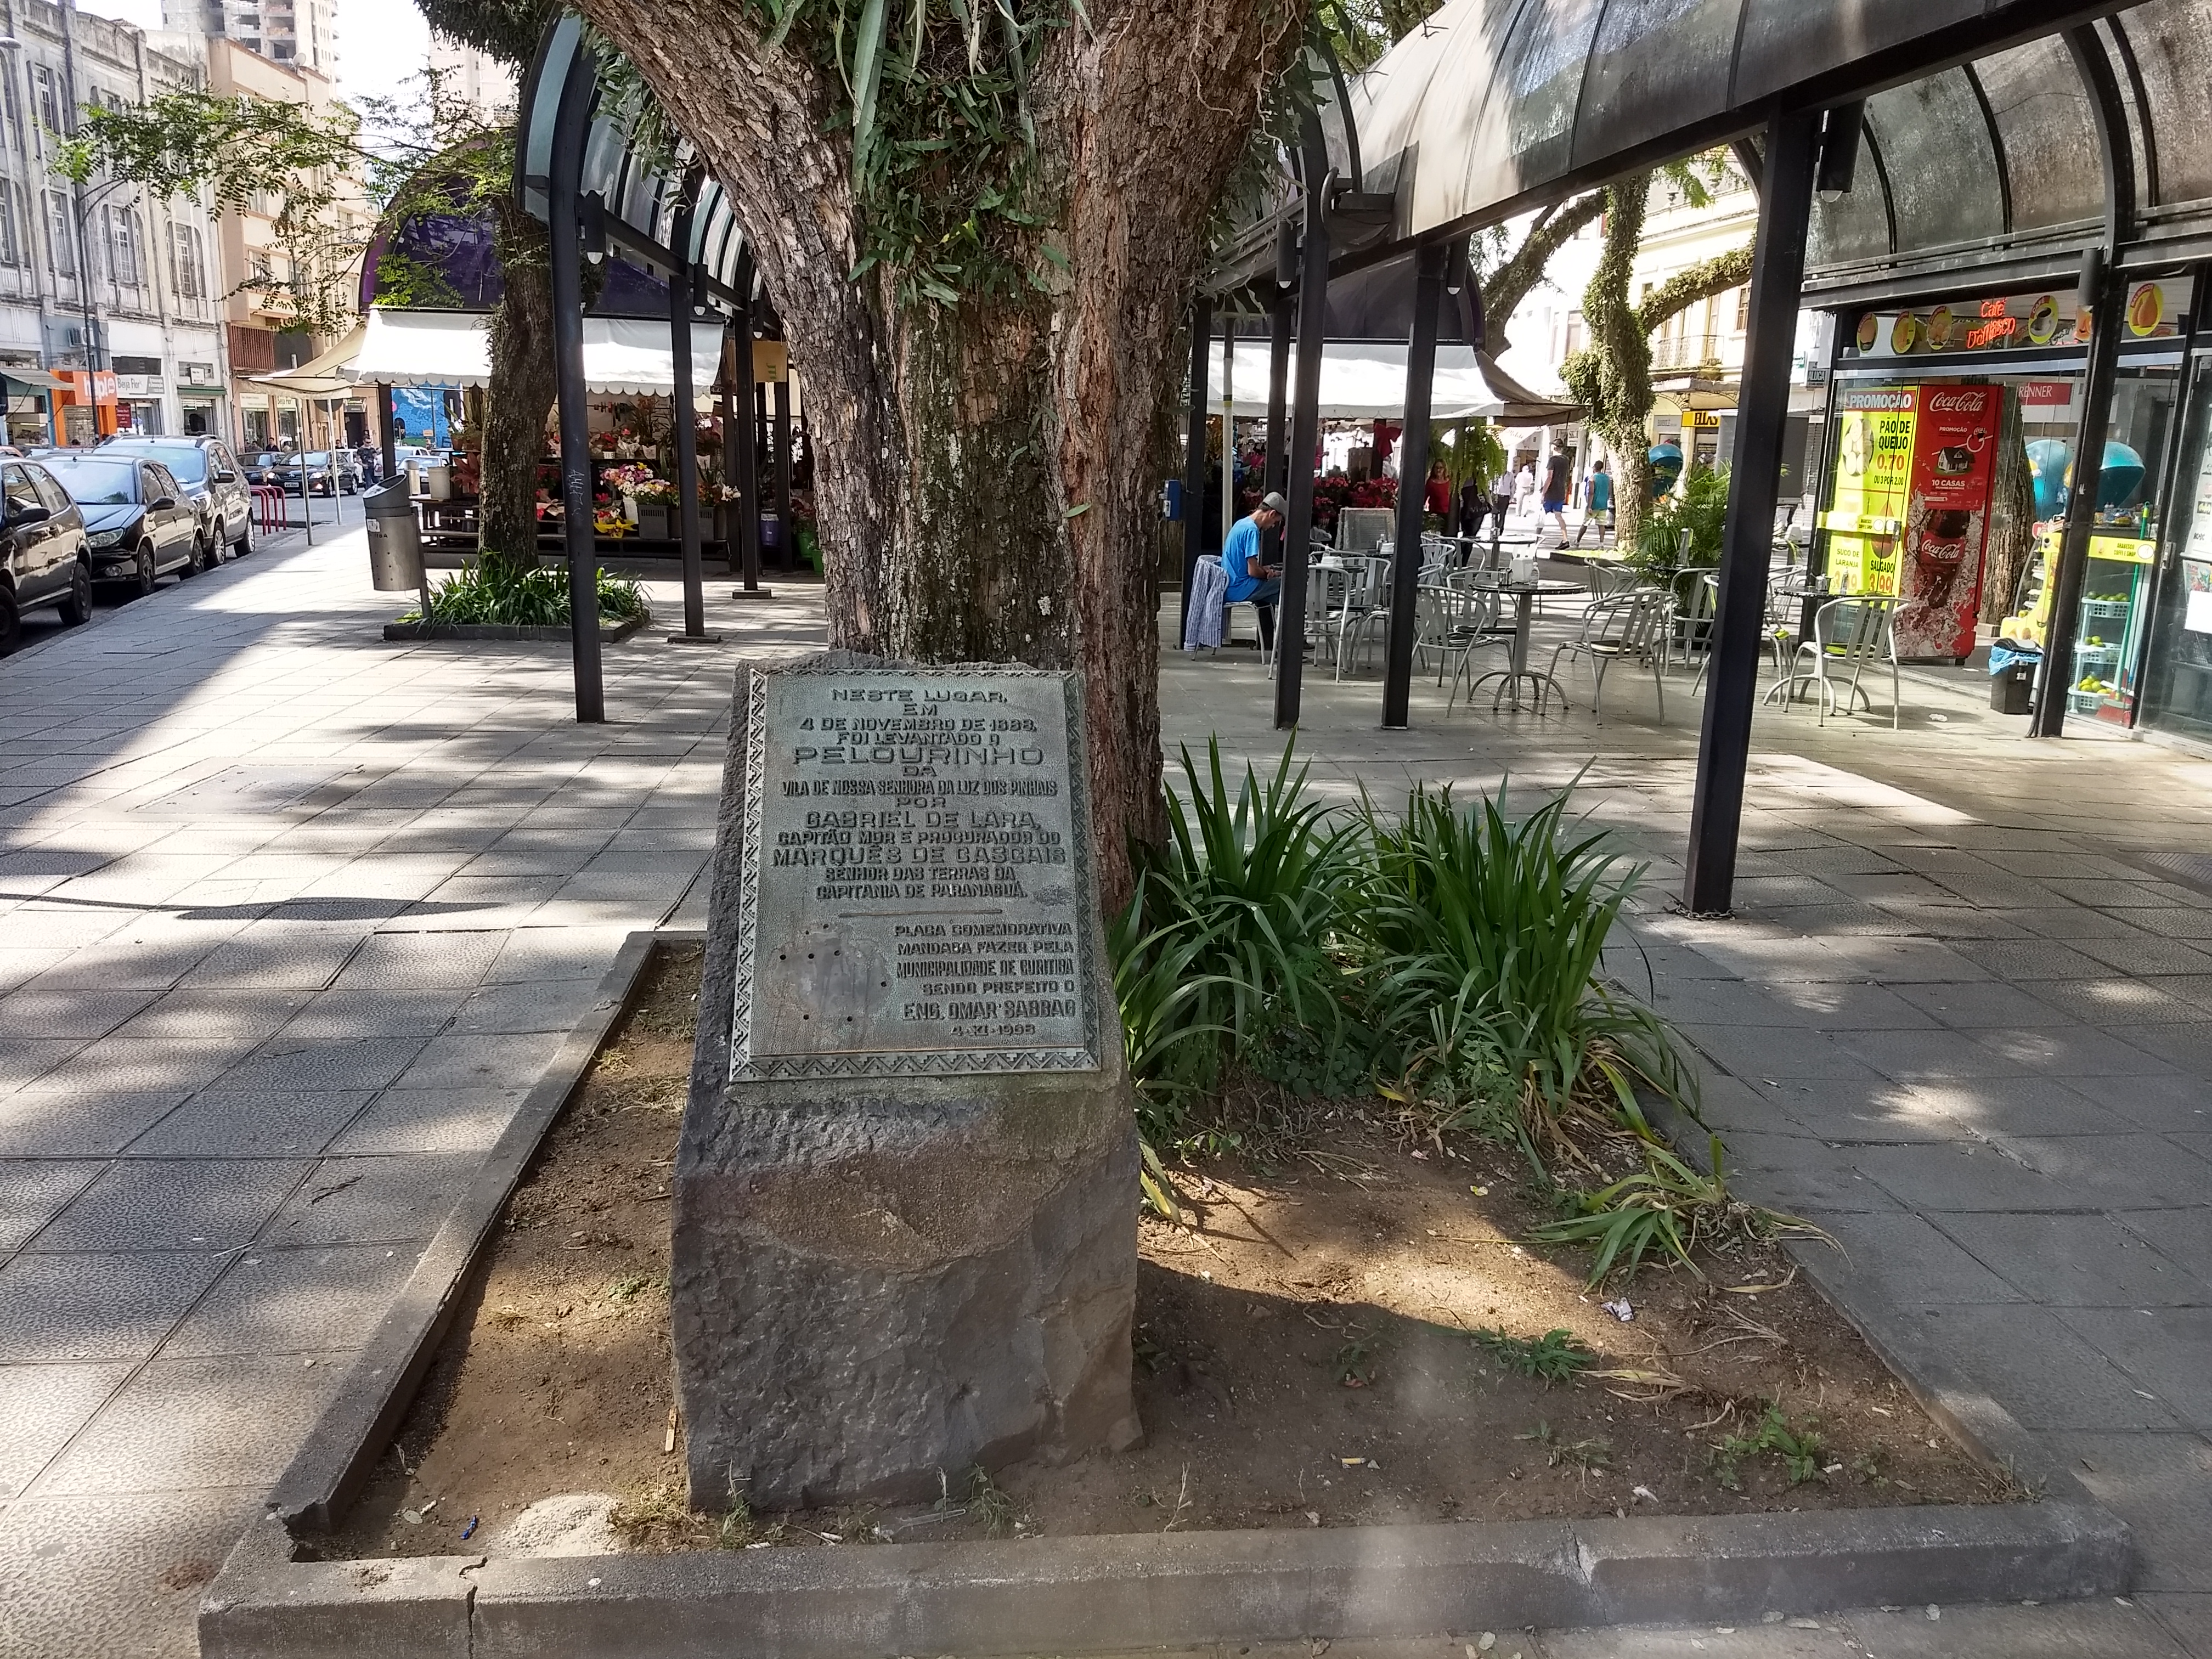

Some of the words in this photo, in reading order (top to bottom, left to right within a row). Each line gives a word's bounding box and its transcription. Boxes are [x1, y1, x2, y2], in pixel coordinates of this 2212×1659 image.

[1808, 371, 1825, 381] ALUGA
[83, 375, 108, 400] hlp!
[2018, 386, 2052, 398] RENNER
[1849, 391, 1912, 411] PROMOÇÃO
[1929, 392, 1988, 412] Coca-Cola
[1880, 417, 1897, 433] PÃO
[1899, 420, 1911, 434] DE
[1878, 436, 1909, 450] QUEIJO
[1877, 454, 1905, 473] 0,70
[1874, 475, 1880, 484] OU
[1884, 476, 1894, 485] POR
[1837, 548, 1851, 556] SUCO
[1922, 539, 1961, 559] Coca-Cola
[1836, 558, 1859, 568] LARANJA
[832, 689, 913, 702] NESTE
[924, 690, 1008, 703] LUGAR,
[902, 703, 938, 715] EM
[799, 718, 814, 731] 4
[821, 718, 847, 731] DE
[852, 718, 955, 731] NOVEMBRO
[959, 718, 985, 731] DE
[837, 732, 869, 745] FOI
[875, 732, 981, 745] LEVANTADO
[989, 733, 1000, 746] O
[793, 746, 1044, 765] PELOURINHO
[903, 766, 937, 777] DA
[782, 781, 810, 797] VILA
[811, 781, 830, 795] DE
[832, 781, 876, 795] NOSSA
[877, 780, 934, 795] SENHORA
[937, 780, 955, 795] DA
[957, 780, 980, 795] LUZ
[981, 780, 1008, 795] DOS
[1009, 781, 1058, 797] PINHAIS
[894, 796, 947, 809] POR
[805, 810, 916, 829] GABRIEL
[925, 810, 959, 828] DE
[970, 811, 1042, 830] LARA,
[776, 828, 850, 846] CAPITÃO
[857, 831, 895, 844] MOR
[900, 831, 912, 844] E
[917, 831, 1032, 845] PROCURADOR
[1037, 832, 1061, 845] DO
[771, 845, 901, 867] MARQUÊS
[911, 847, 945, 864] DE
[956, 847, 1065, 864] CASCAIS
[825, 866, 888, 881] SENHOR
[891, 866, 924, 880] DAS
[929, 867, 989, 881] TERRAS
[994, 867, 1015, 881] DA
[816, 884, 899, 899] CAPITANIA
[904, 883, 924, 898] DE
[894, 925, 946, 936] PLACA
[952, 923, 1073, 936] COMEMORATIVA
[897, 941, 972, 955] MANDADA
[977, 941, 1028, 953] FAZER
[1032, 941, 1074, 953] PELA
[896, 960, 996, 978] MUNICIPALIDADE
[1000, 960, 1016, 975] DE
[1019, 959, 1074, 975] CURITIBA
[921, 983, 977, 995] SENDO
[982, 981, 1058, 994] PREFEITO
[1063, 980, 1074, 992] O
[902, 1002, 944, 1021] ENG.
[947, 1001, 997, 1019] OMAR
